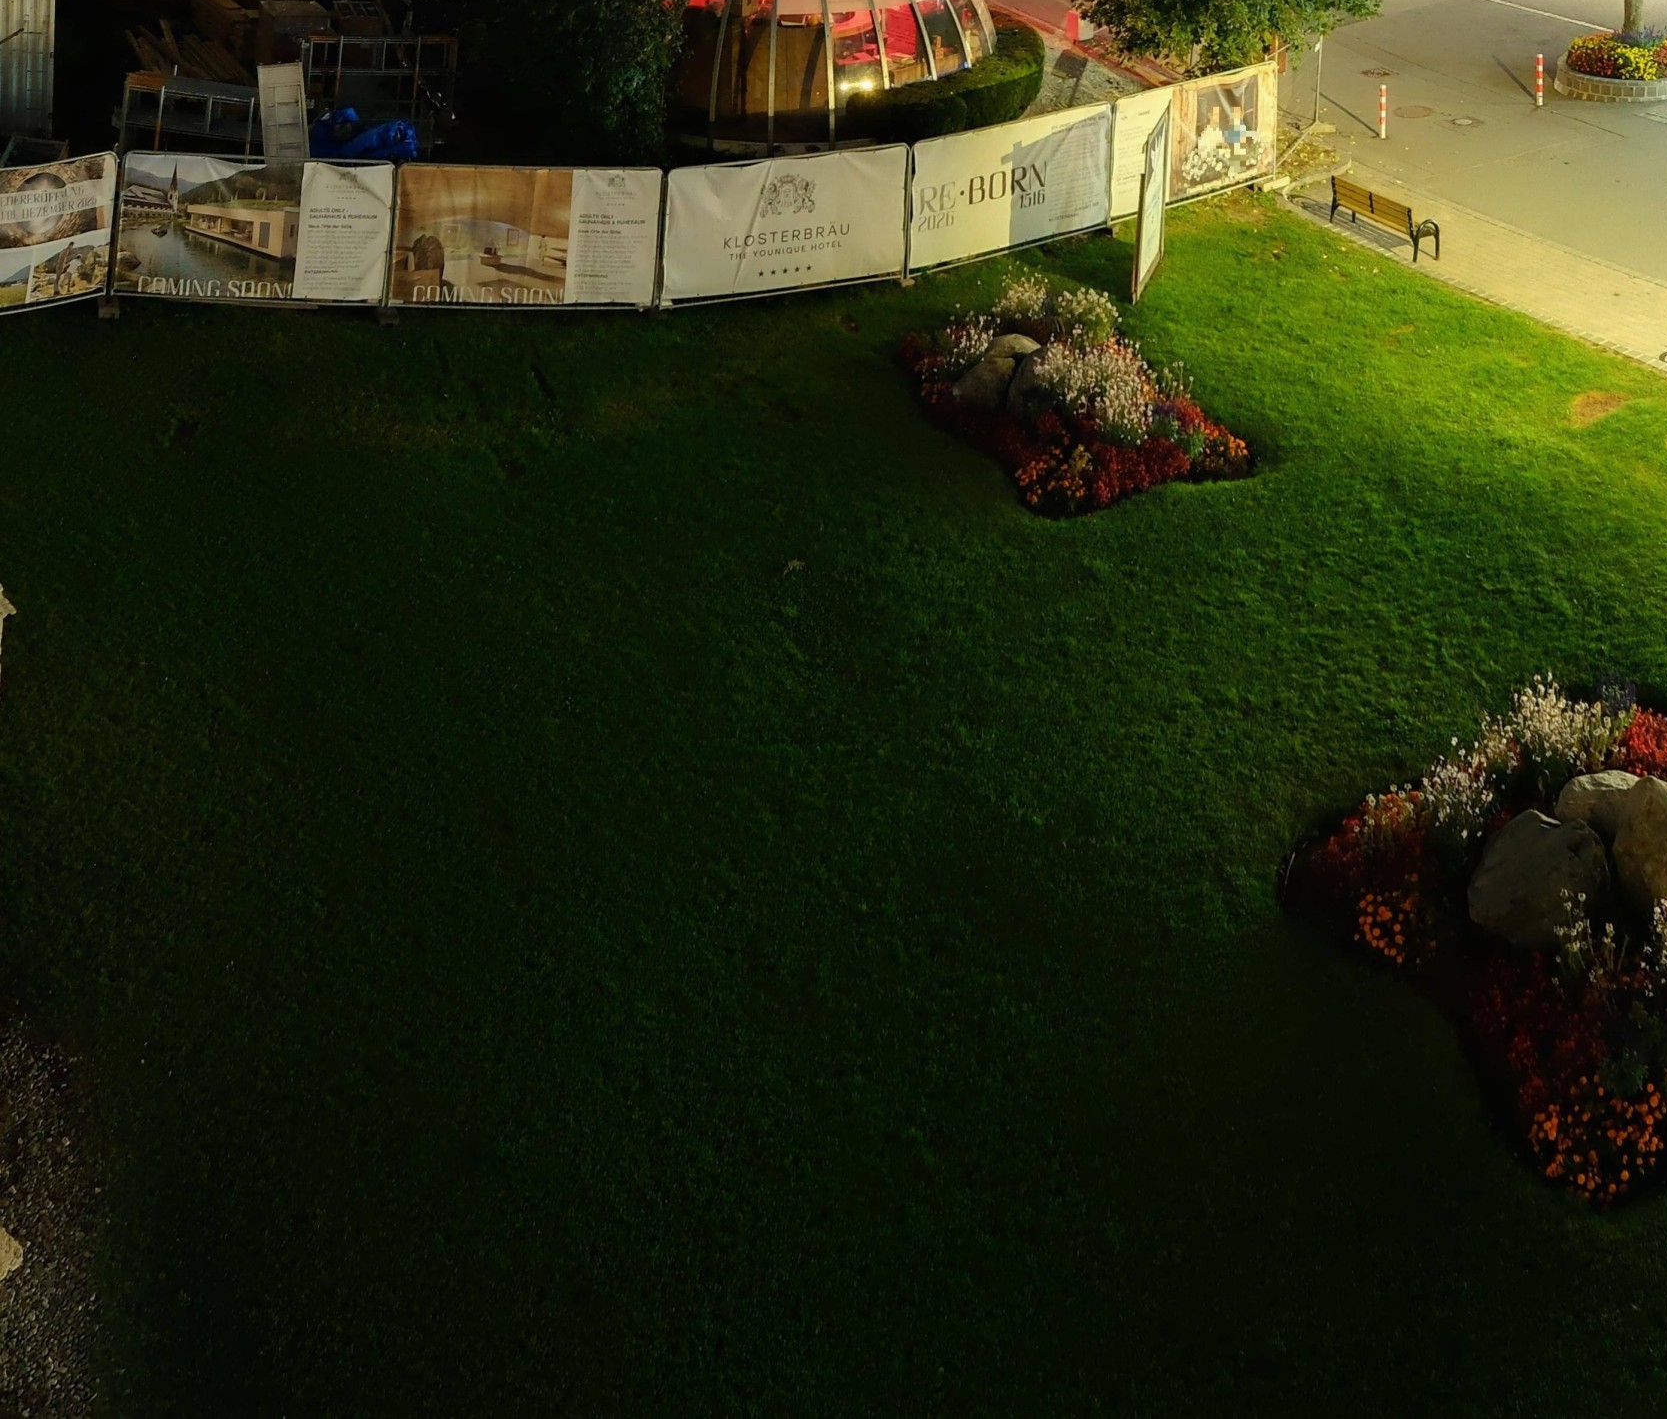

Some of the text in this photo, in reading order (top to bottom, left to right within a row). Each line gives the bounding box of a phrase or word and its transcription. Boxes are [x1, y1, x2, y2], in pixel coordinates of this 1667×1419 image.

[1020, 189, 1046, 210] 1516
[918, 211, 955, 232] 2026
[723, 222, 850, 250] KLOSTERBRÄU
[729, 240, 842, 260] THE YOUNIQUE HOTEL
[137, 276, 221, 297] COMING
[413, 285, 493, 303] COMING
